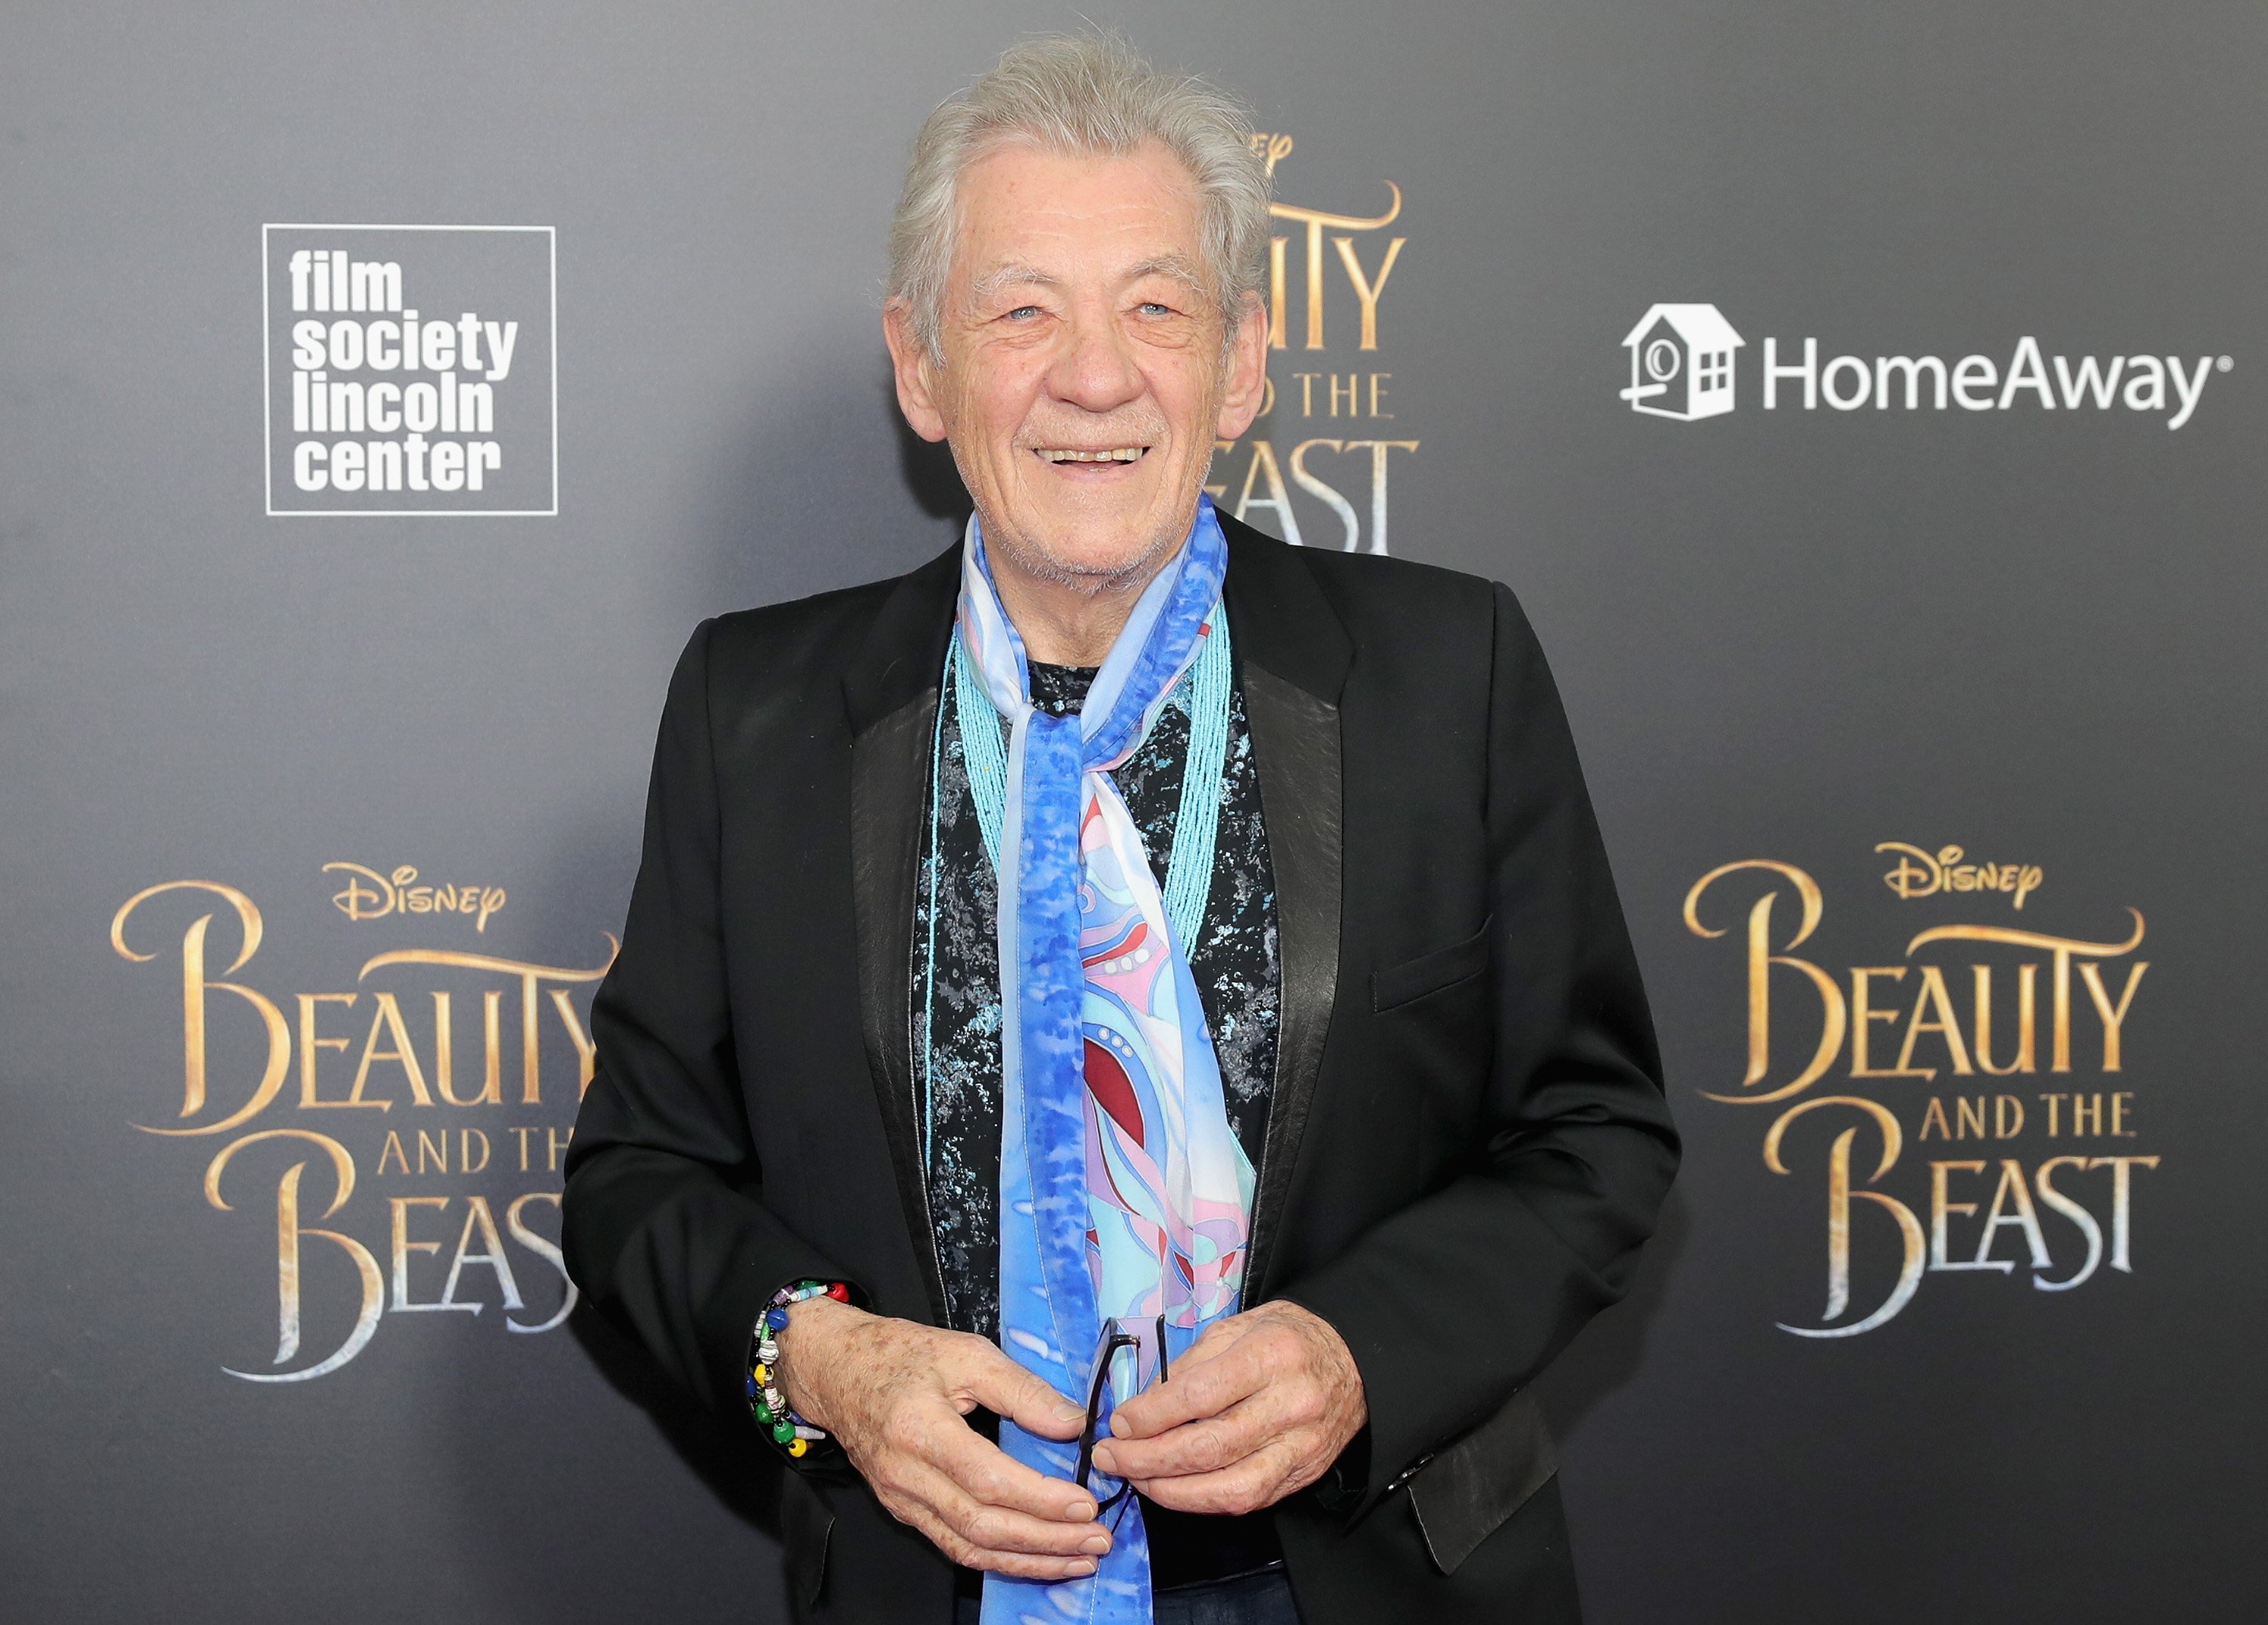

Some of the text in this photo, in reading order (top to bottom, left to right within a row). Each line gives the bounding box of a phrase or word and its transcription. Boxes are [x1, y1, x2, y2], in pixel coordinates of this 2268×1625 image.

[290, 250, 402, 312] film
[292, 309, 519, 381] society
[292, 371, 494, 433] lincoln
[1292, 373, 1395, 419] THE
[293, 433, 501, 492] center
[1206, 438, 1421, 557] AST
[1683, 858, 2151, 1105] BEAUTY
[1919, 1091, 2136, 1141] AND THE
[378, 1126, 575, 1176] AND TH
[1762, 1095, 2161, 1338] BEAST
[204, 1128, 579, 1383] BEAS
